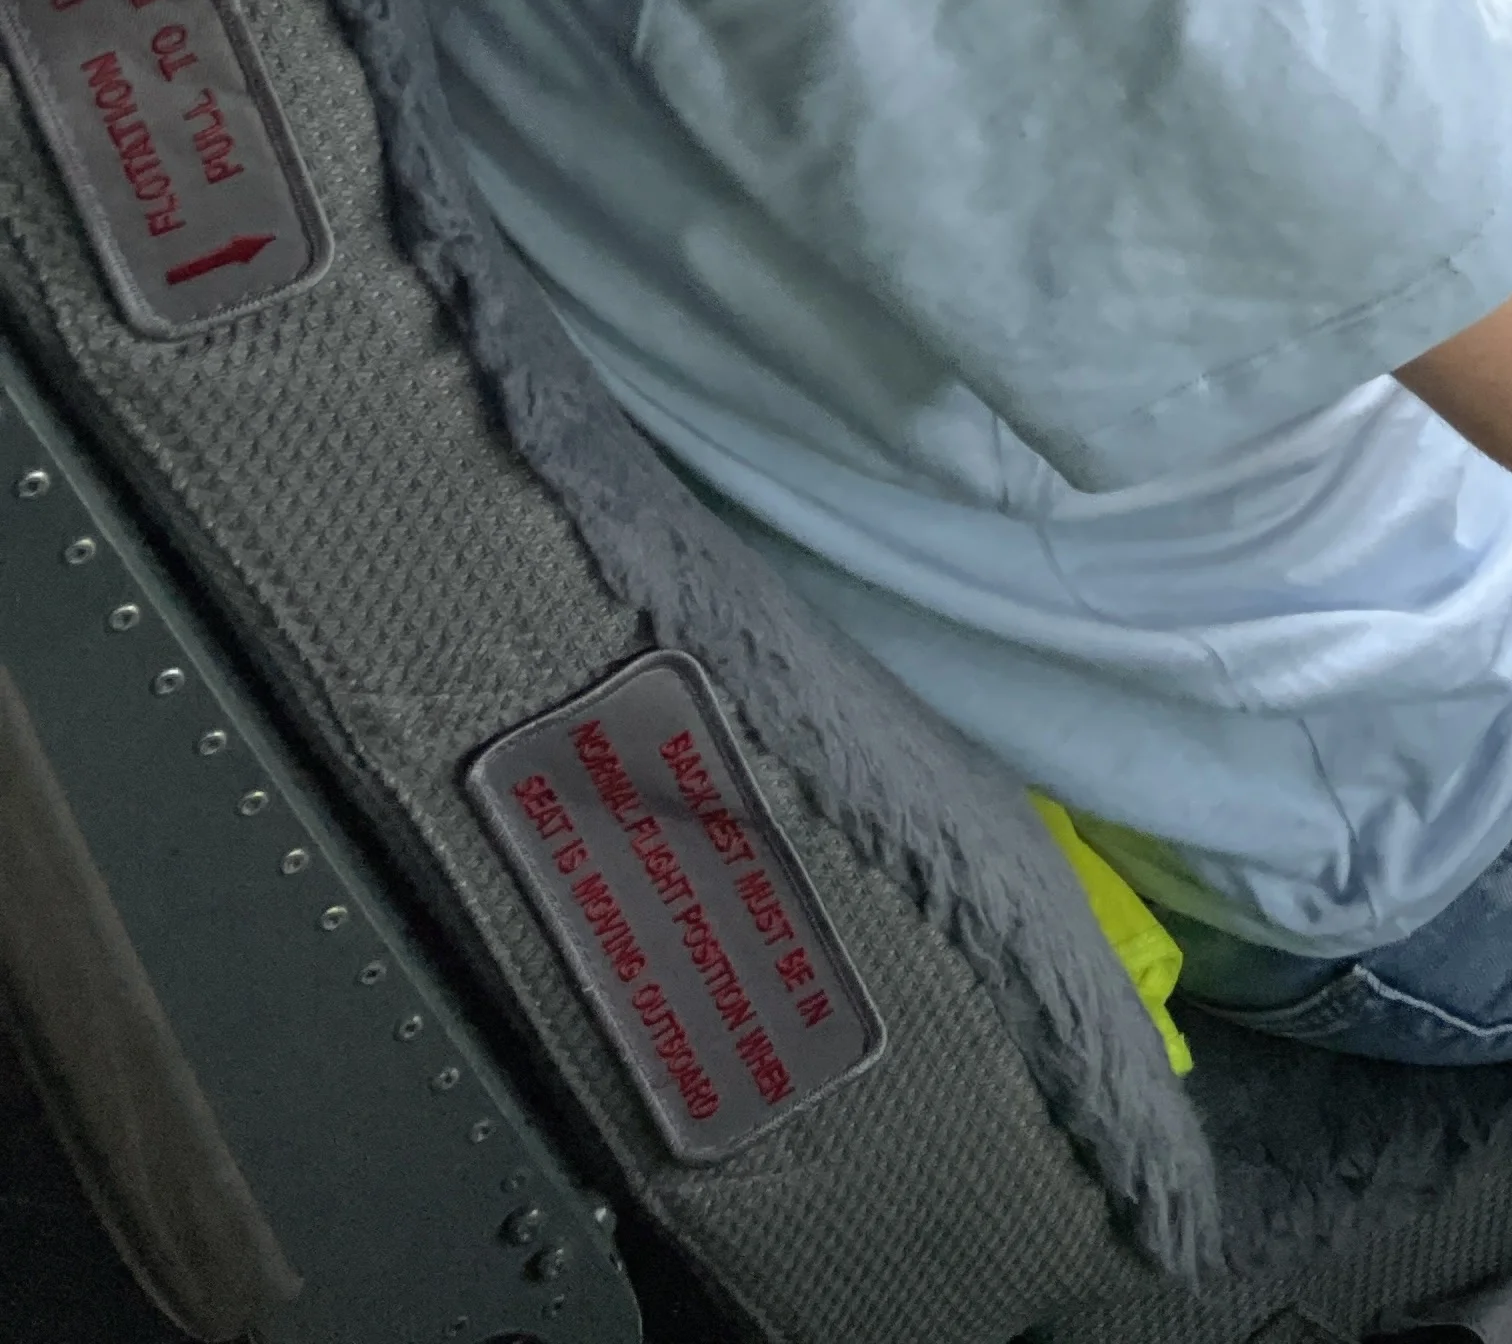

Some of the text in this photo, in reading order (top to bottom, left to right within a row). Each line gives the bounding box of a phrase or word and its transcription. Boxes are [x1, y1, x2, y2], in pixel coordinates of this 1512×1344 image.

[151, 23, 198, 83] TO
[183, 87, 245, 185] PULL
[80, 51, 187, 237] FLOTATION
[511, 773, 721, 1121] SEAT IS MOVING OUTBOARD
[568, 719, 797, 1106] NORMAL FLIGHT POSITION WHEN
[734, 868, 795, 946] MUST
[774, 946, 815, 994] BE
[796, 989, 834, 1029] IN
